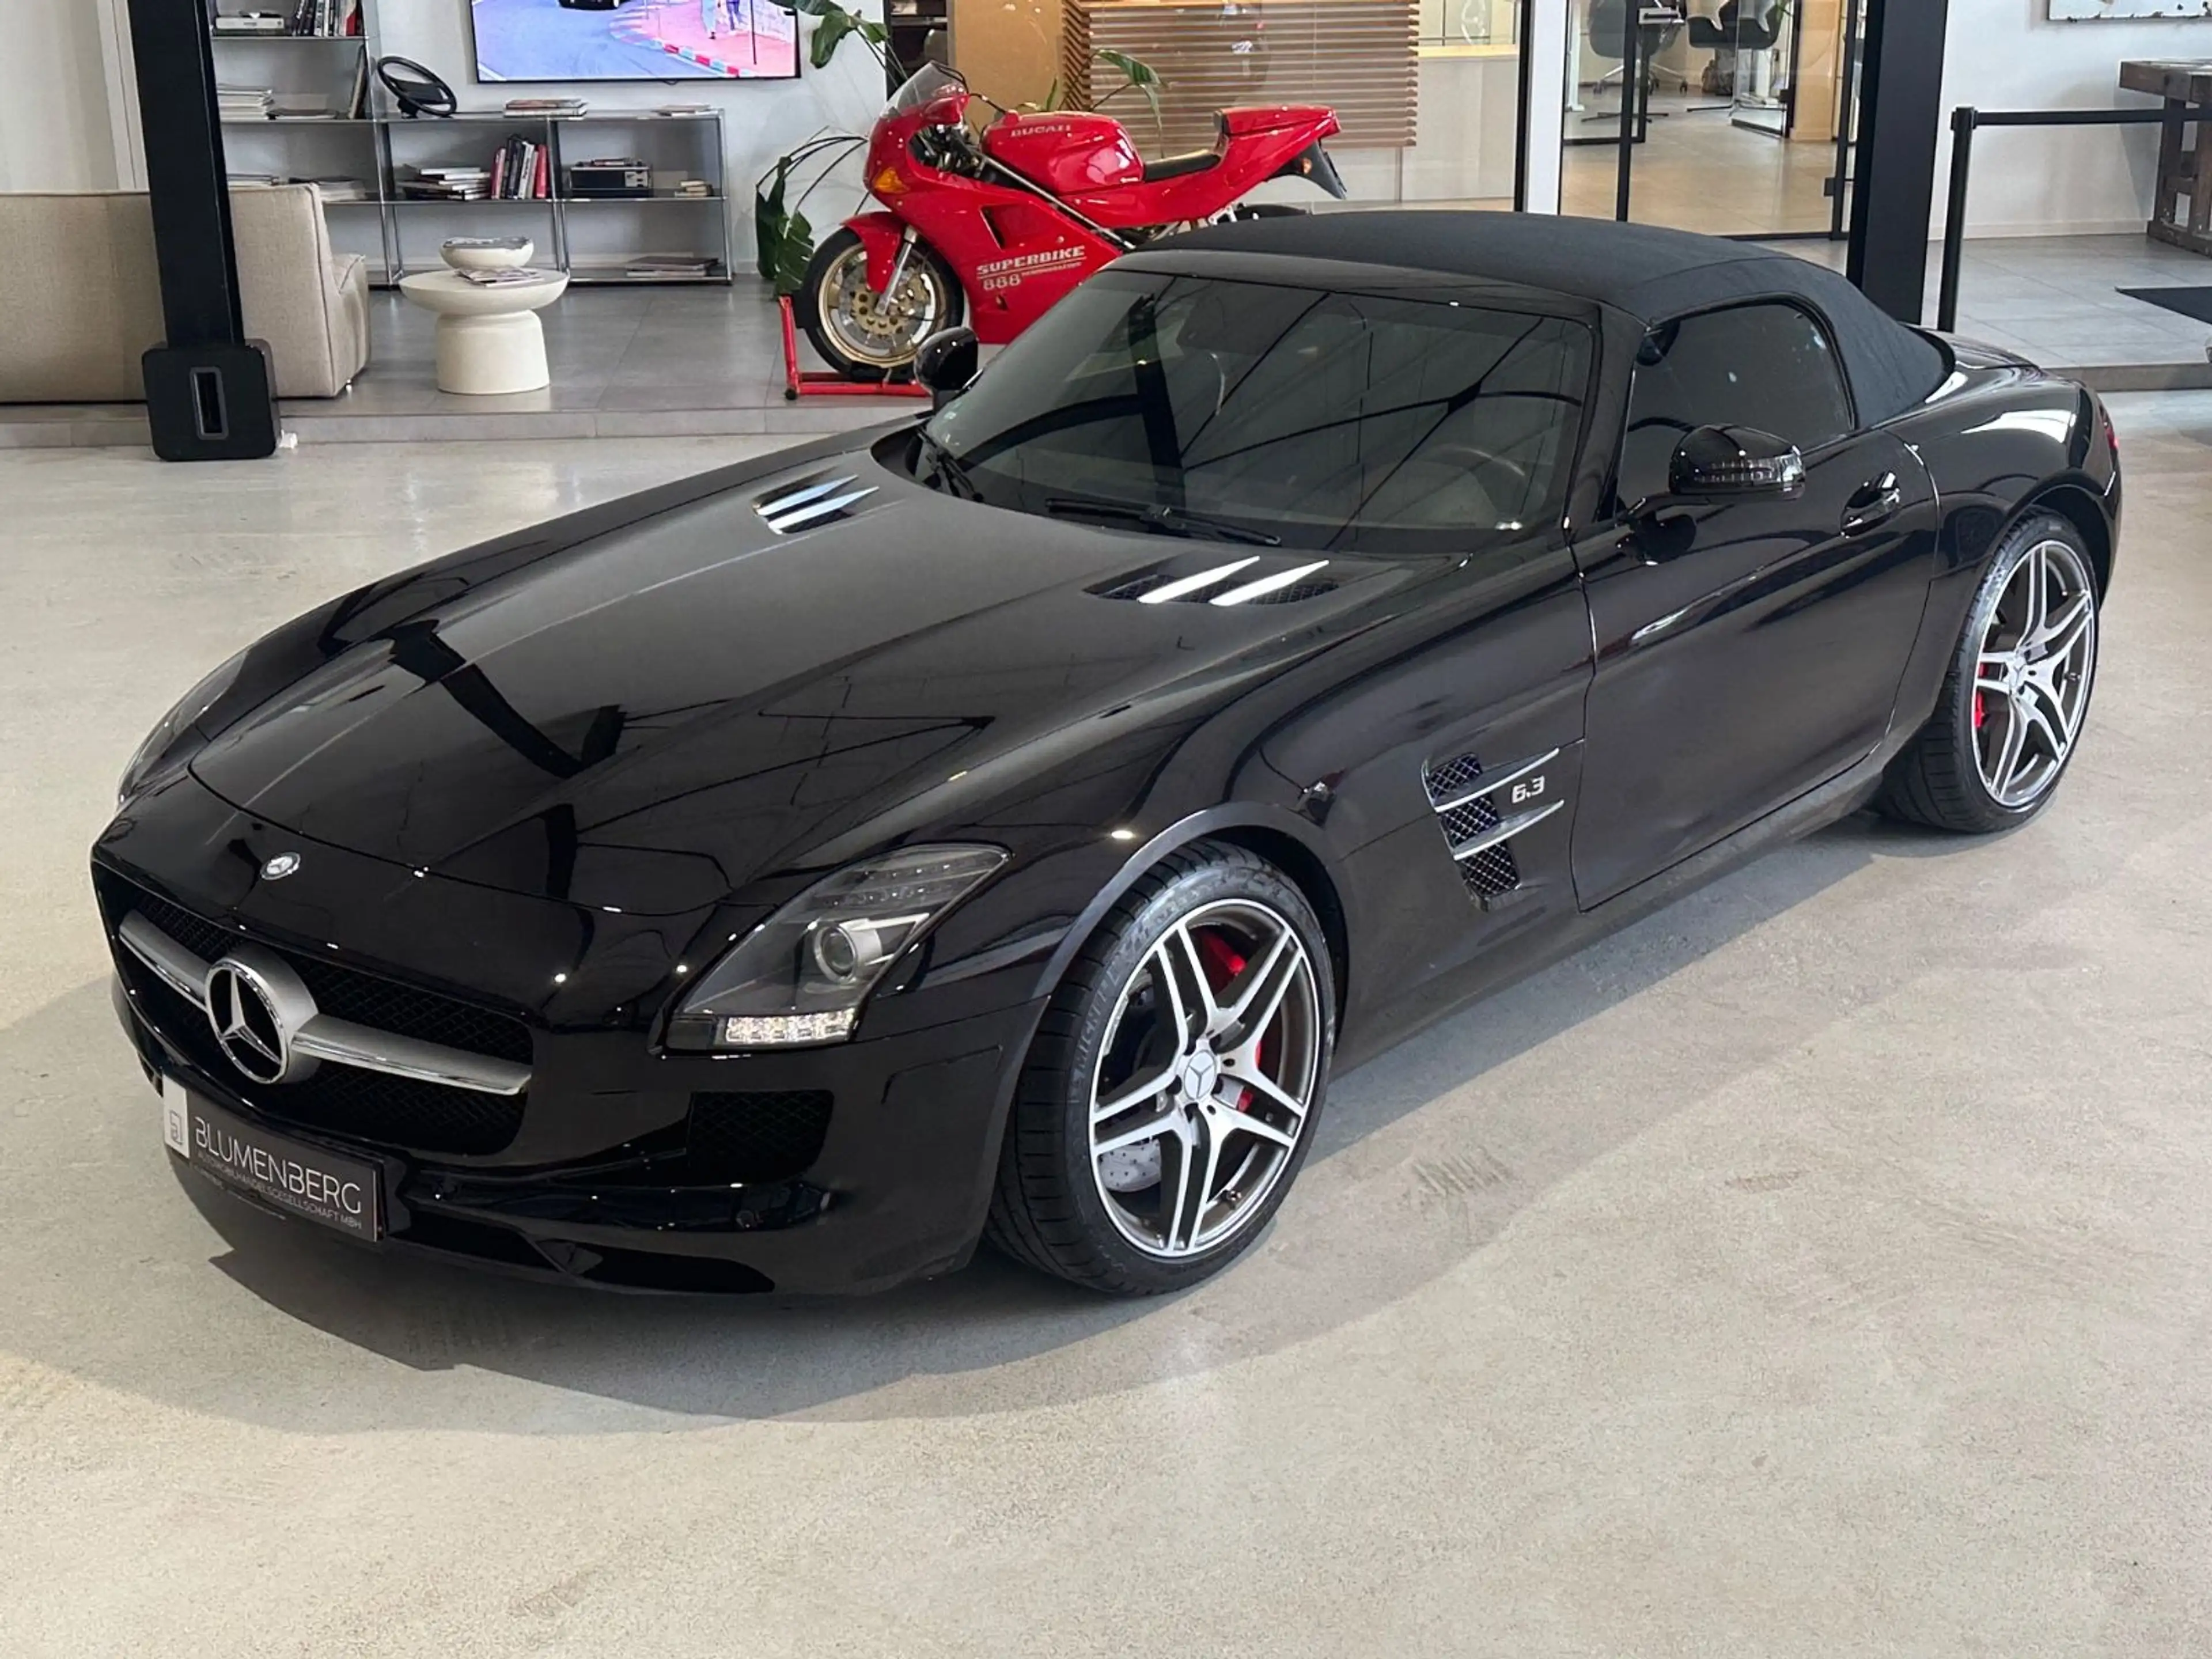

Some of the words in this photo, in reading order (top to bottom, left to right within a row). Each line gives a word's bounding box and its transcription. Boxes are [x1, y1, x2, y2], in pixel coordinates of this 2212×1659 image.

[977, 245, 1085, 274] SUPERBIKE
[983, 274, 1021, 290] 888
[1512, 775, 1545, 803] 6.3
[195, 1116, 361, 1214] BLUMENBERG
